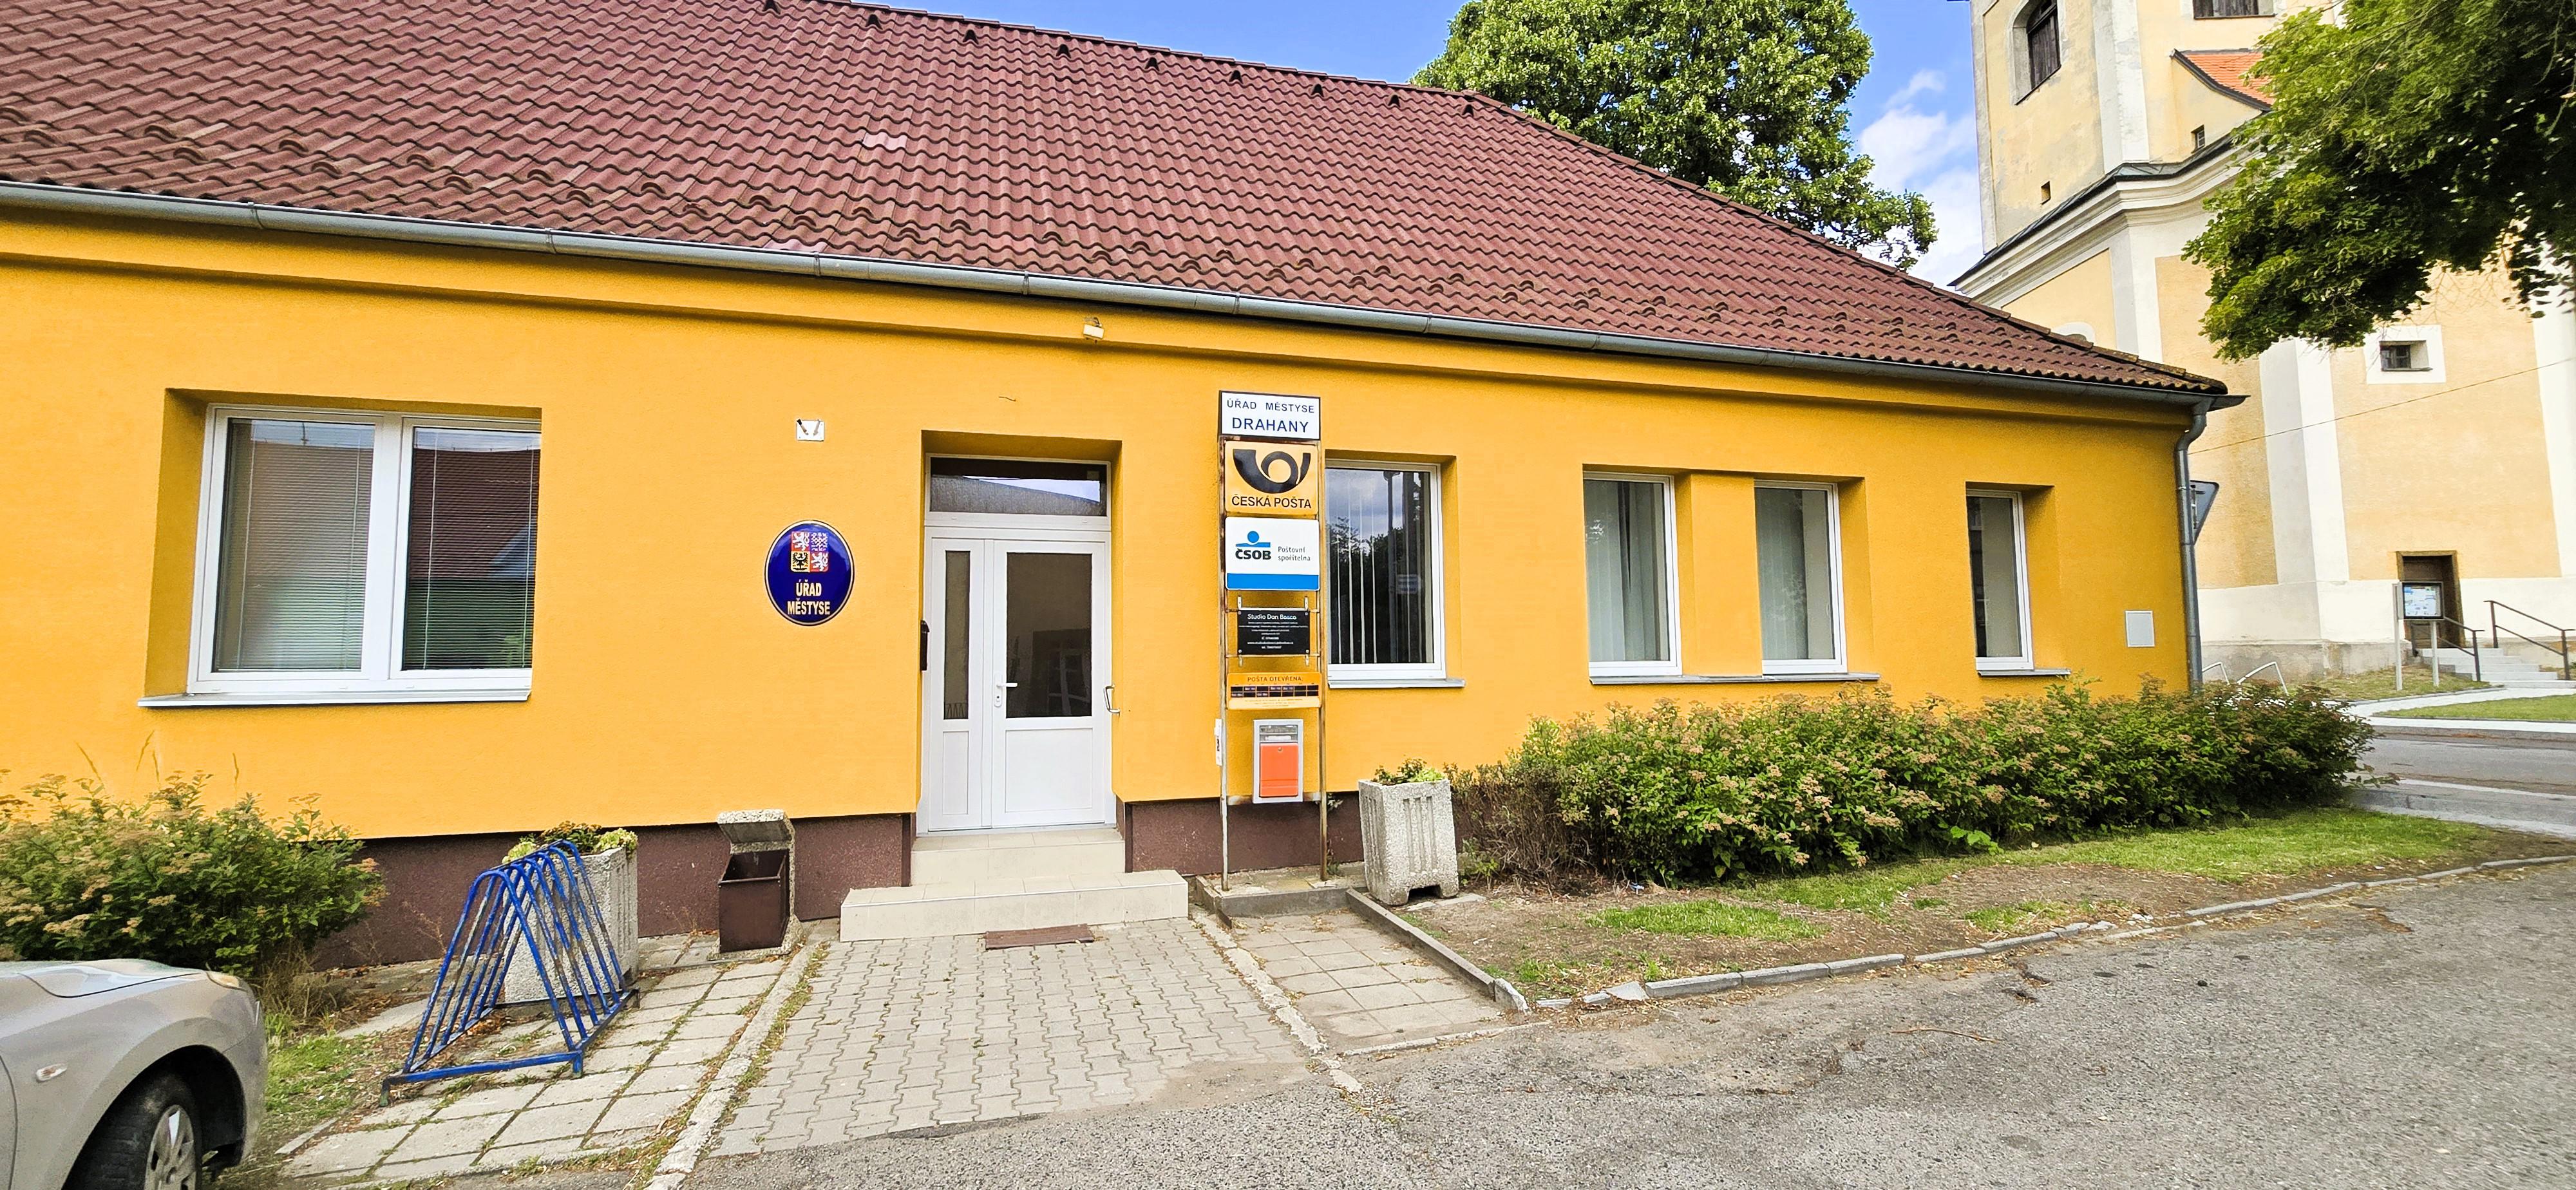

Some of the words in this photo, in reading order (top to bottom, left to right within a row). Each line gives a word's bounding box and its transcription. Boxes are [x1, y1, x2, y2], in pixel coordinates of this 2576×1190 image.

[1227, 397, 1256, 410] ÚŘAD
[1265, 401, 1314, 413] MĚSTYSE
[1232, 417, 1309, 433] DRAHANY
[1231, 494, 1271, 507] ČESKÁ
[1274, 496, 1312, 509] POŠTA
[1235, 548, 1272, 560] ČSOB
[796, 578, 822, 596] ÚŘAD
[787, 597, 830, 615] MĚSTYSE
